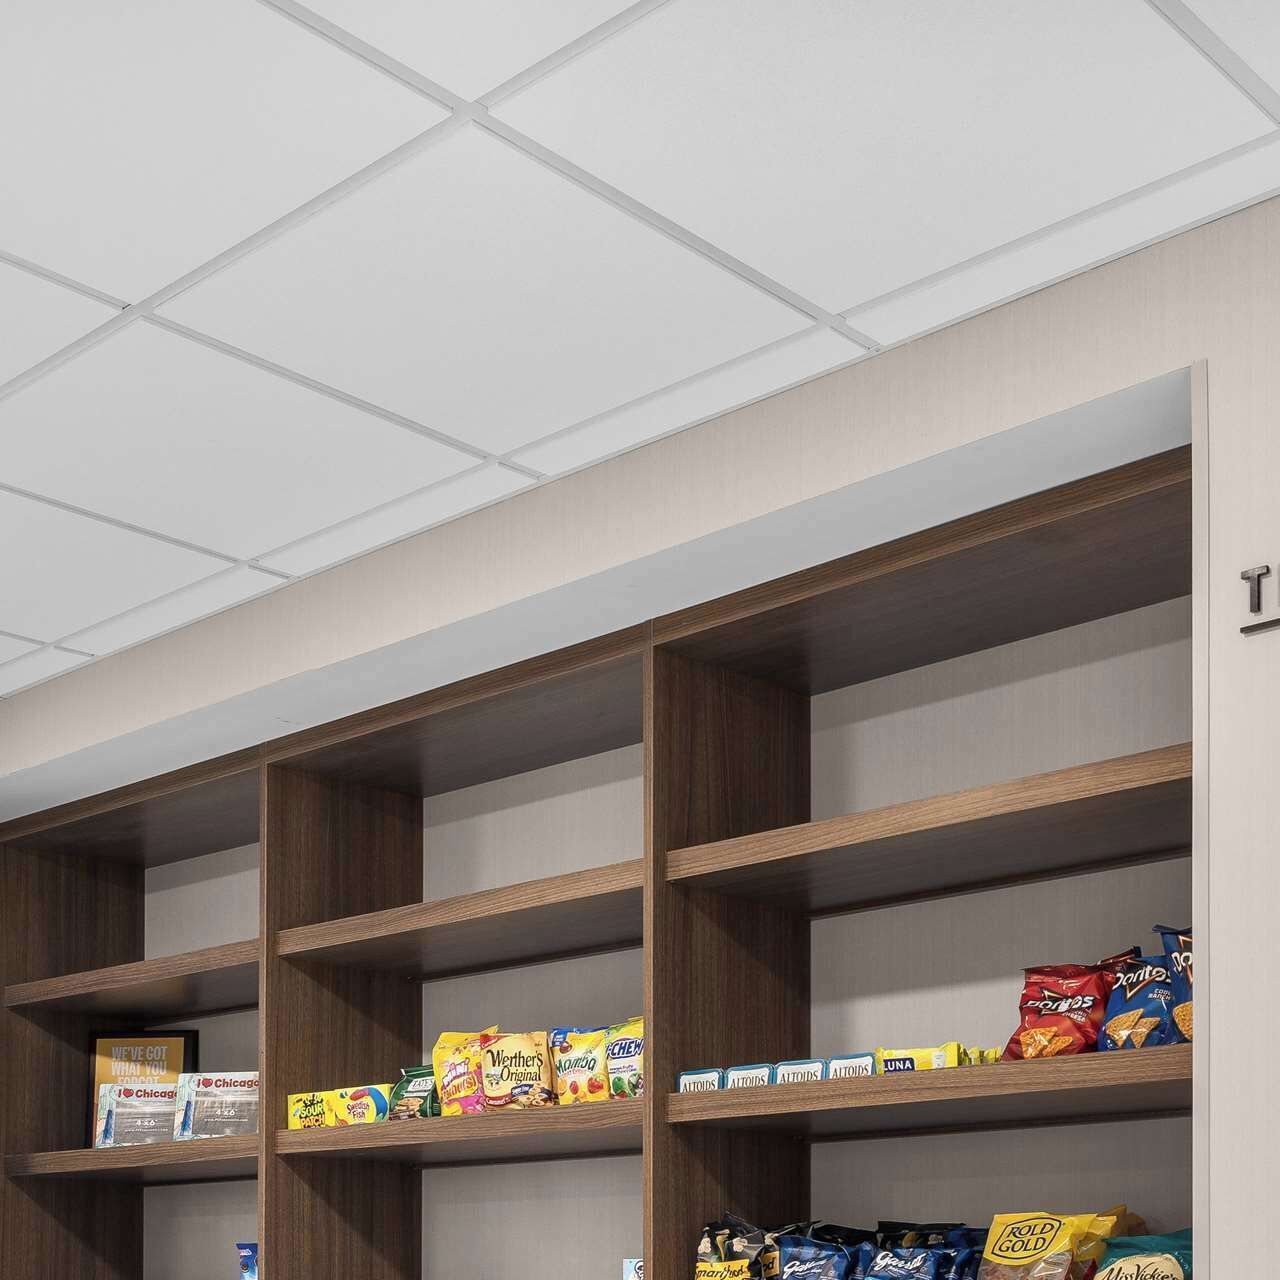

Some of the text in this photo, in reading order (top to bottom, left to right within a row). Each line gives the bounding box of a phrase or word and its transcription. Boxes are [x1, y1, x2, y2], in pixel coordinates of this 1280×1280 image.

[112, 1046, 168, 1060] WE'VE GOT
[486, 1050, 543, 1068] Werther's
[112, 1061, 167, 1075] WHAT YOU
[556, 1054, 597, 1078] Mamba
[884, 1059, 912, 1071] LUNA
[500, 1065, 541, 1085] Original
[214, 1077, 260, 1090] Chicago
[135, 1088, 177, 1100] Chicag
[301, 1104, 324, 1118] SOUR
[347, 1101, 370, 1114] Swedish
[352, 1109, 366, 1120] Fish
[301, 1115, 325, 1127] PATCH
[1007, 1221, 1055, 1239] ROLD
[999, 1236, 1047, 1253] GOLD
